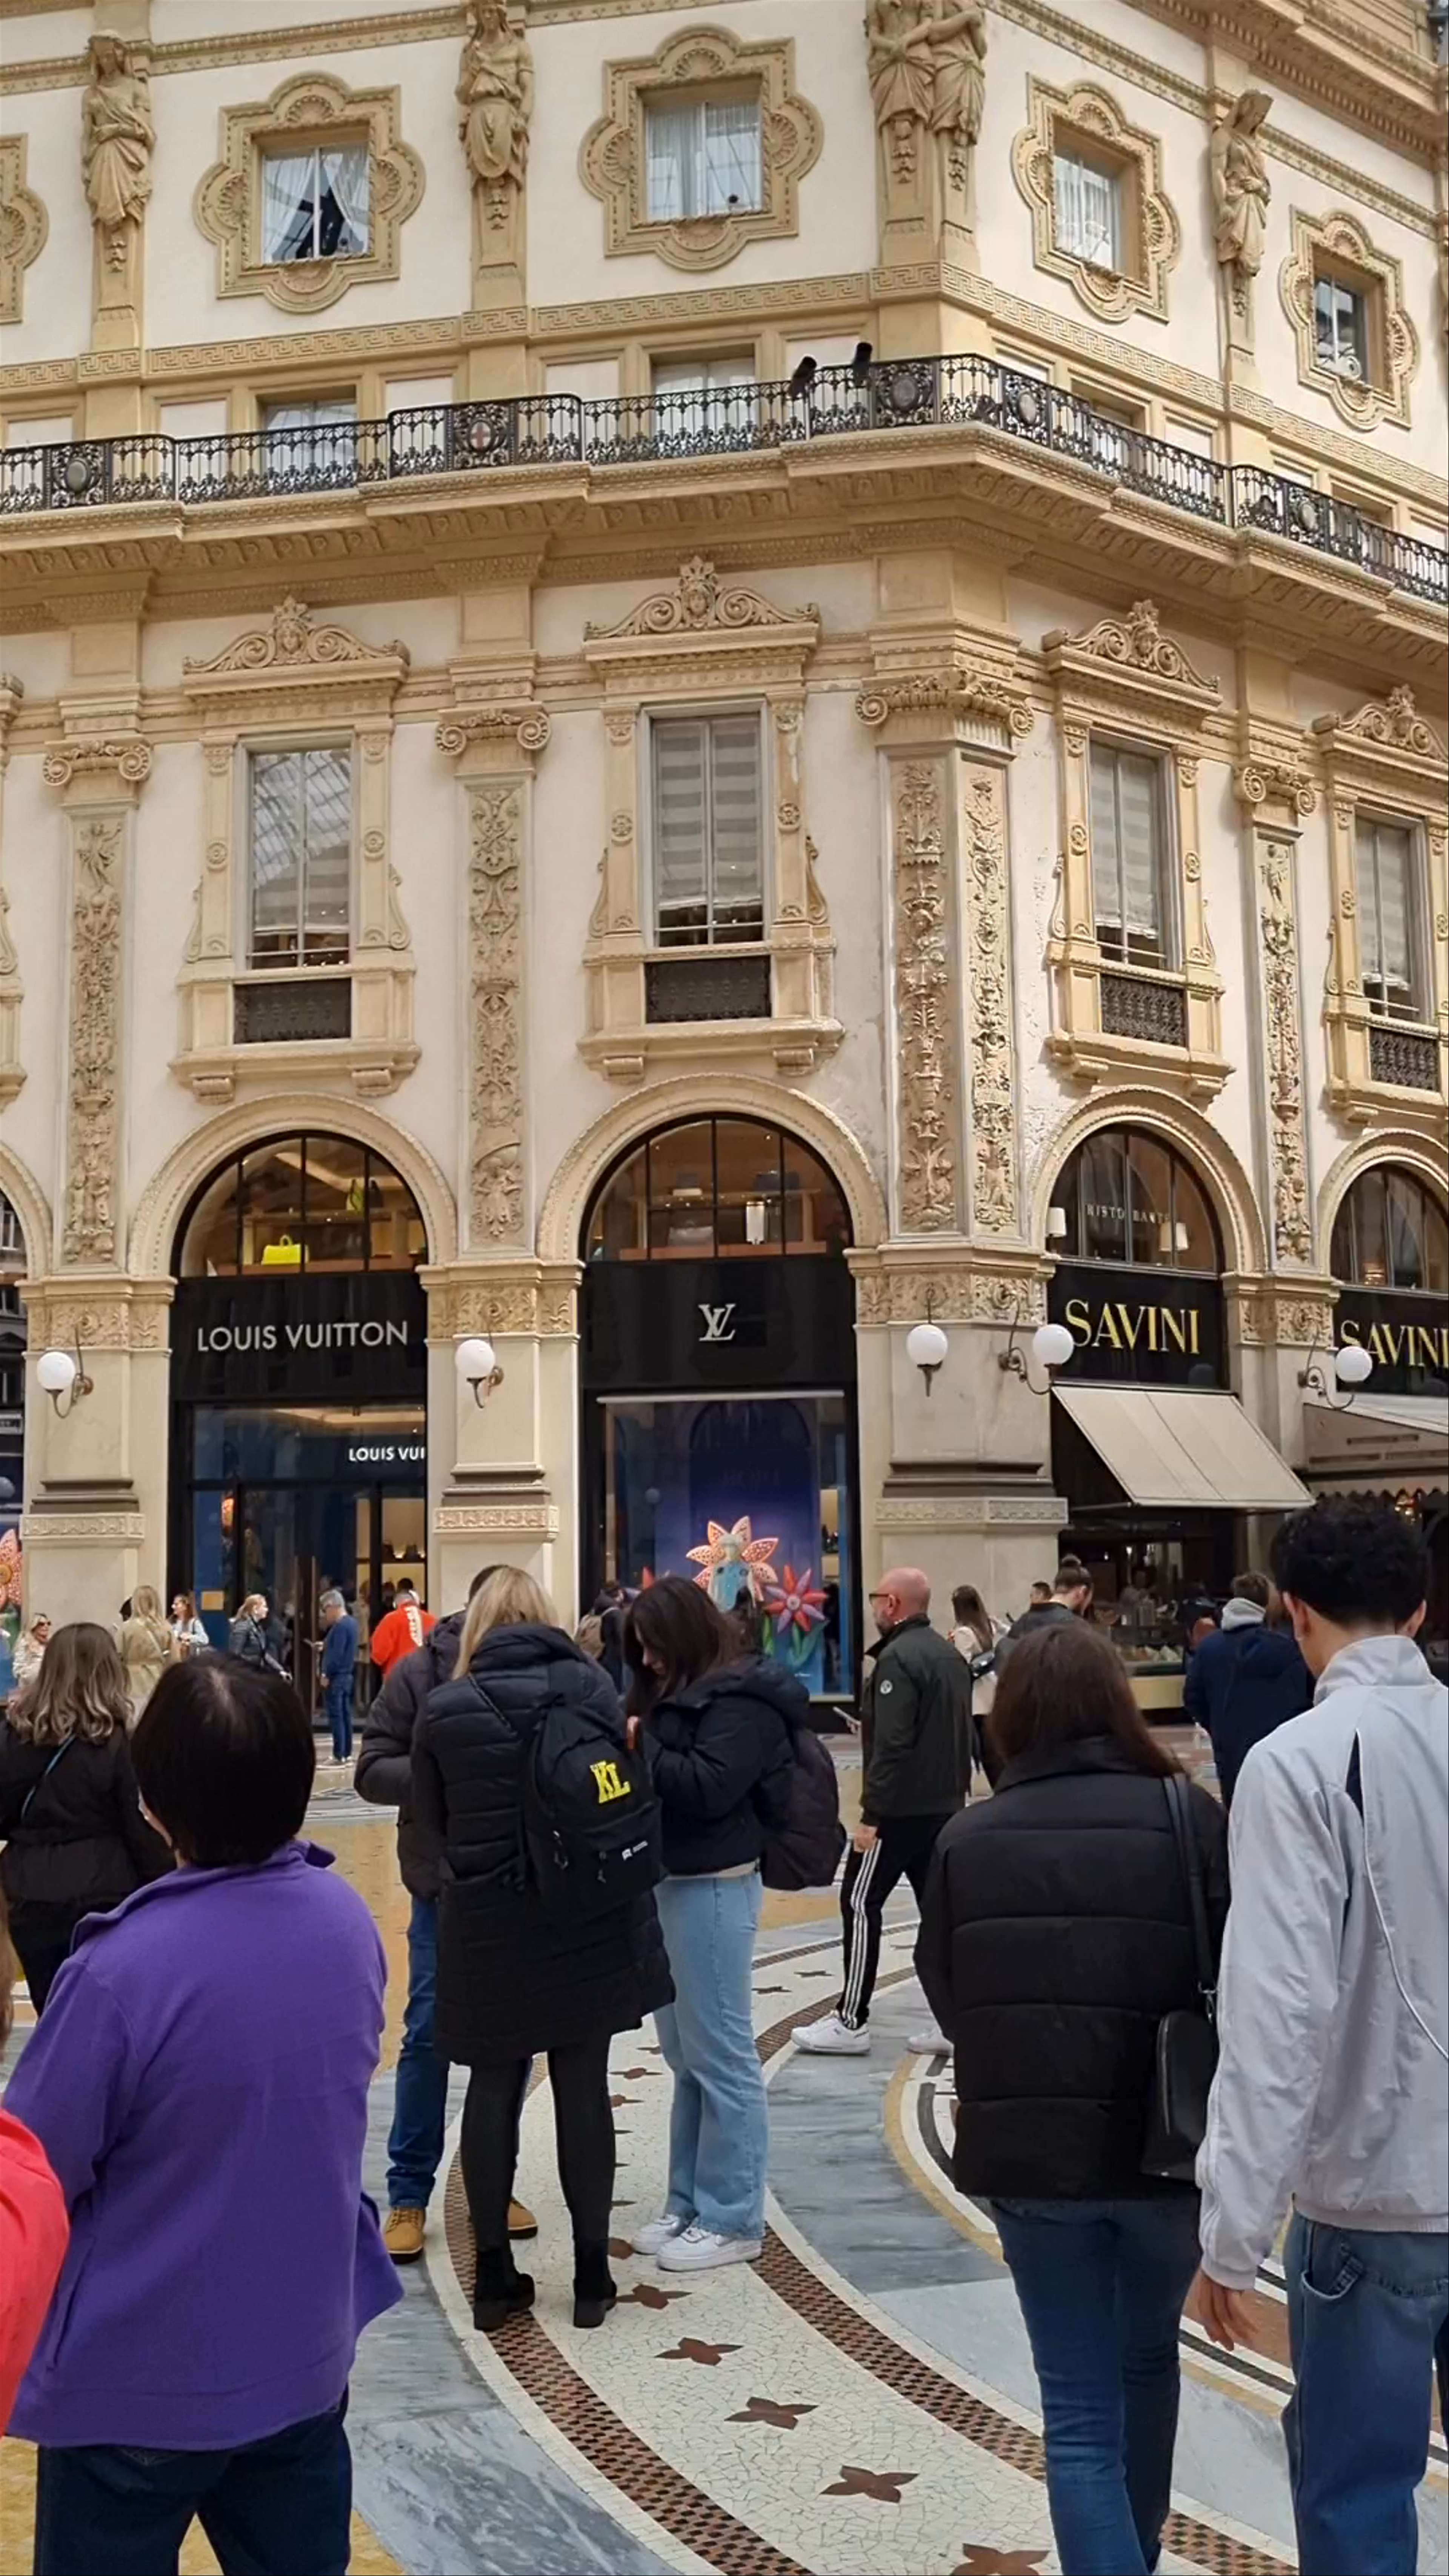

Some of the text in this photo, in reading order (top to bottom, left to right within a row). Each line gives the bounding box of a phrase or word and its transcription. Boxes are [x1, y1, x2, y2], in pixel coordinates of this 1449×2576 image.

[198, 1321, 408, 1352] LOUIS VUITTON
[698, 1304, 736, 1341] LV
[1065, 1299, 1200, 1355] SAVINI
[349, 1447, 395, 1461] LOUIS
